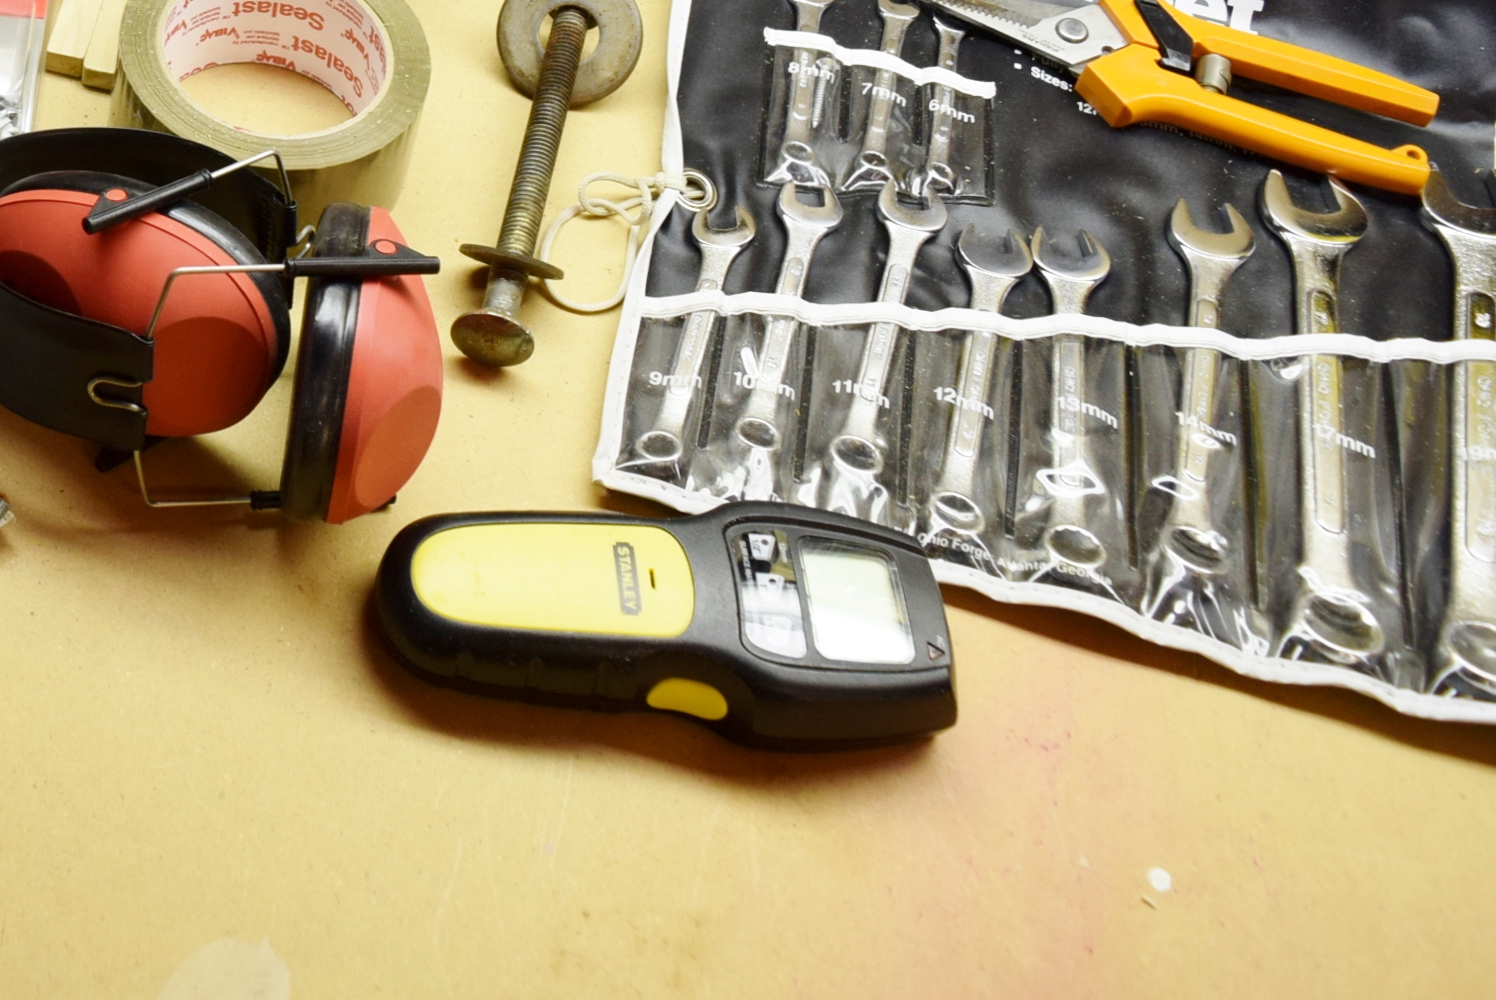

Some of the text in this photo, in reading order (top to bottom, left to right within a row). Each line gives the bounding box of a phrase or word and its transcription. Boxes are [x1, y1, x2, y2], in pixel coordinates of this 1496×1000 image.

[788, 61, 836, 84] 8mm
[1030, 66, 1073, 93] Sizes:
[861, 82, 906, 108] 7mm
[928, 98, 976, 124] 6mm
[649, 371, 702, 389] 9mm
[933, 386, 995, 420] 12mm
[1058, 396, 1119, 430] 13mm
[1175, 411, 1237, 446] 14mm
[1312, 423, 1376, 459] 17mm
[617, 545, 639, 612] STANLEY
